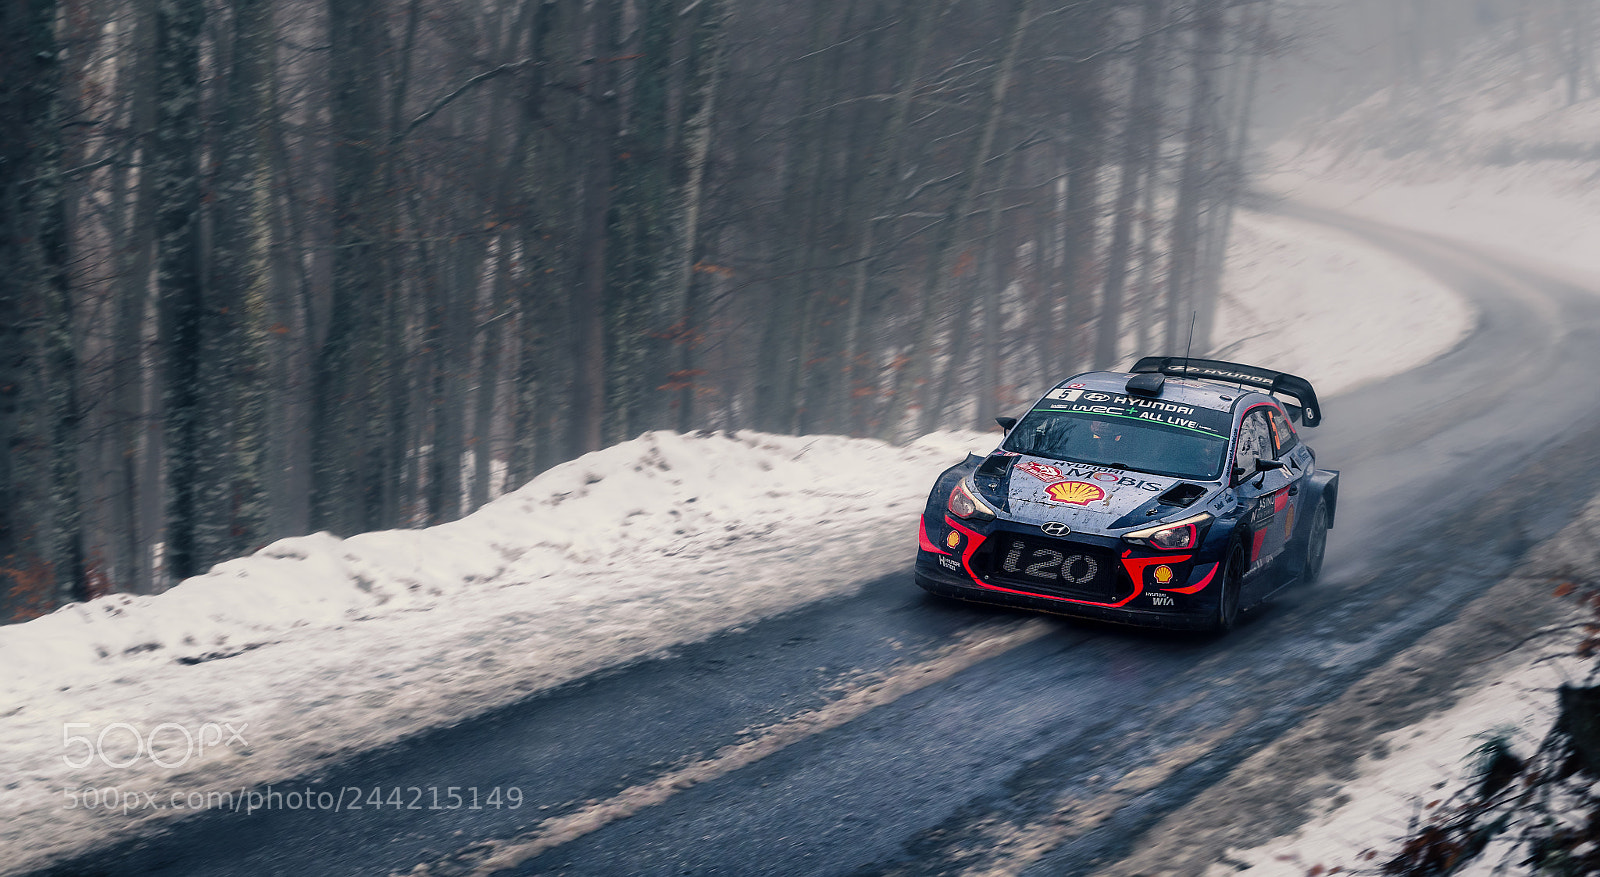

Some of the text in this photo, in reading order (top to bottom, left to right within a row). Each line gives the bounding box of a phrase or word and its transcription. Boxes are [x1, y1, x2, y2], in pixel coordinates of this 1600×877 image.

[1203, 369, 1274, 384] HYUNDA
[1058, 389, 1072, 399] 5
[1113, 396, 1195, 415] HYUNDAI
[1139, 411, 1164, 422] ALL
[1167, 416, 1198, 430] LIVE
[1053, 461, 1125, 475] HYUNDAI
[1065, 468, 1163, 492] MOBIS
[1003, 541, 1098, 584] i20
[1152, 597, 1174, 605] WIA
